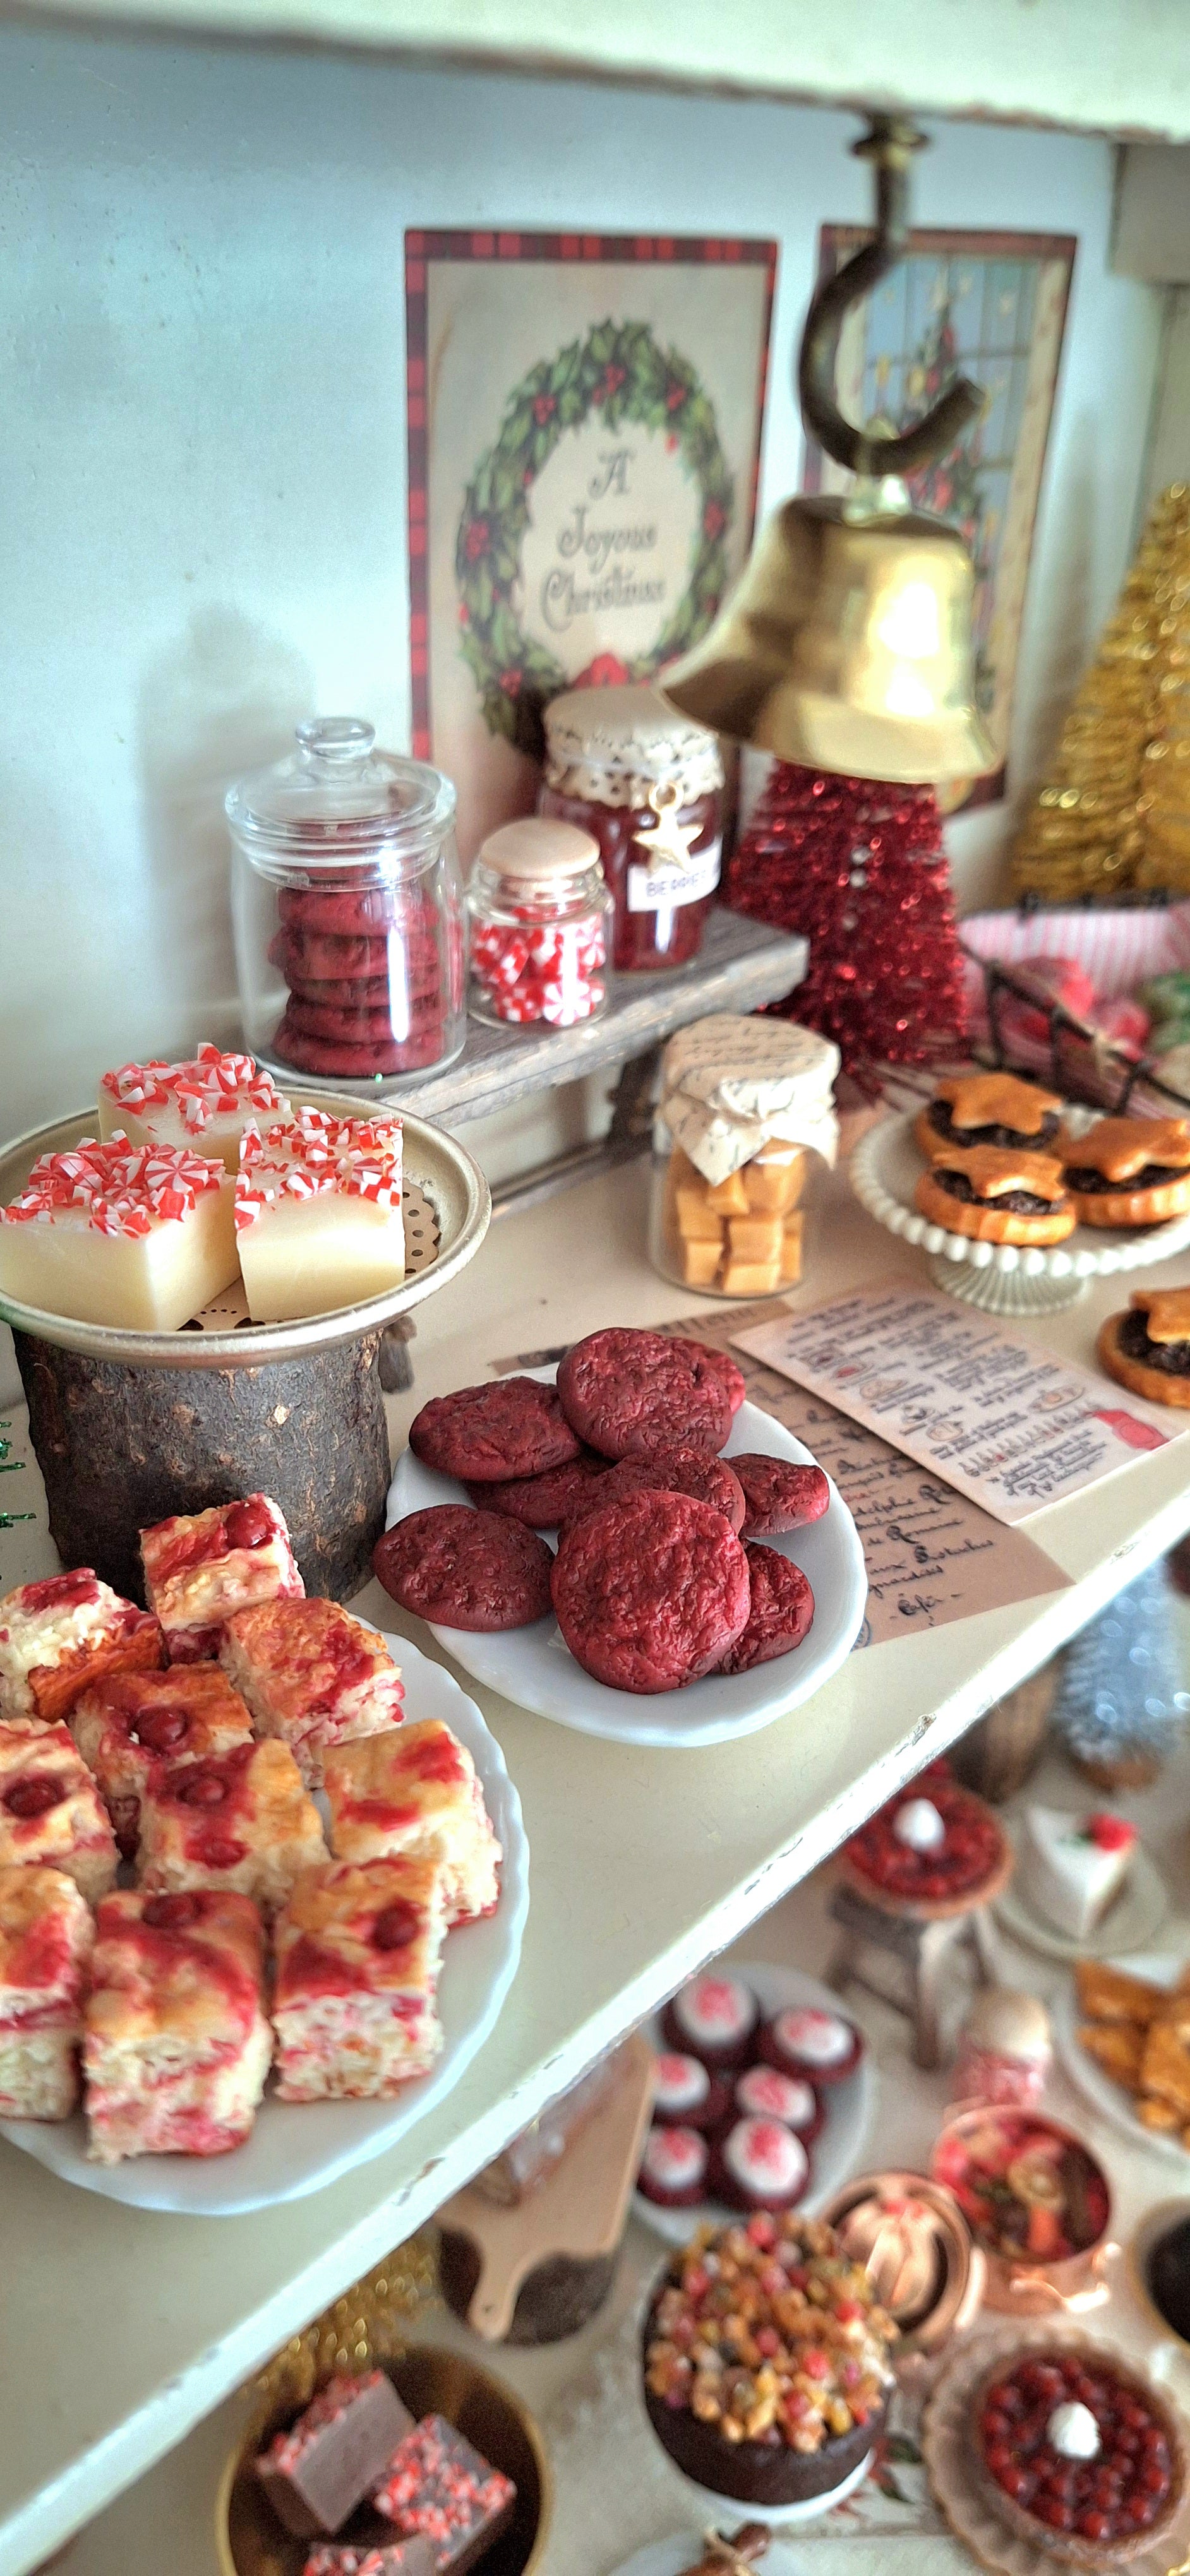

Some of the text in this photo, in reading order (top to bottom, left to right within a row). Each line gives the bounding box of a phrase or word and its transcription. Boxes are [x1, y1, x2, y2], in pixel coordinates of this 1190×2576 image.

[588, 450, 637, 500] A
[558, 505, 659, 575] Joyous
[541, 566, 665, 632] Christmas
